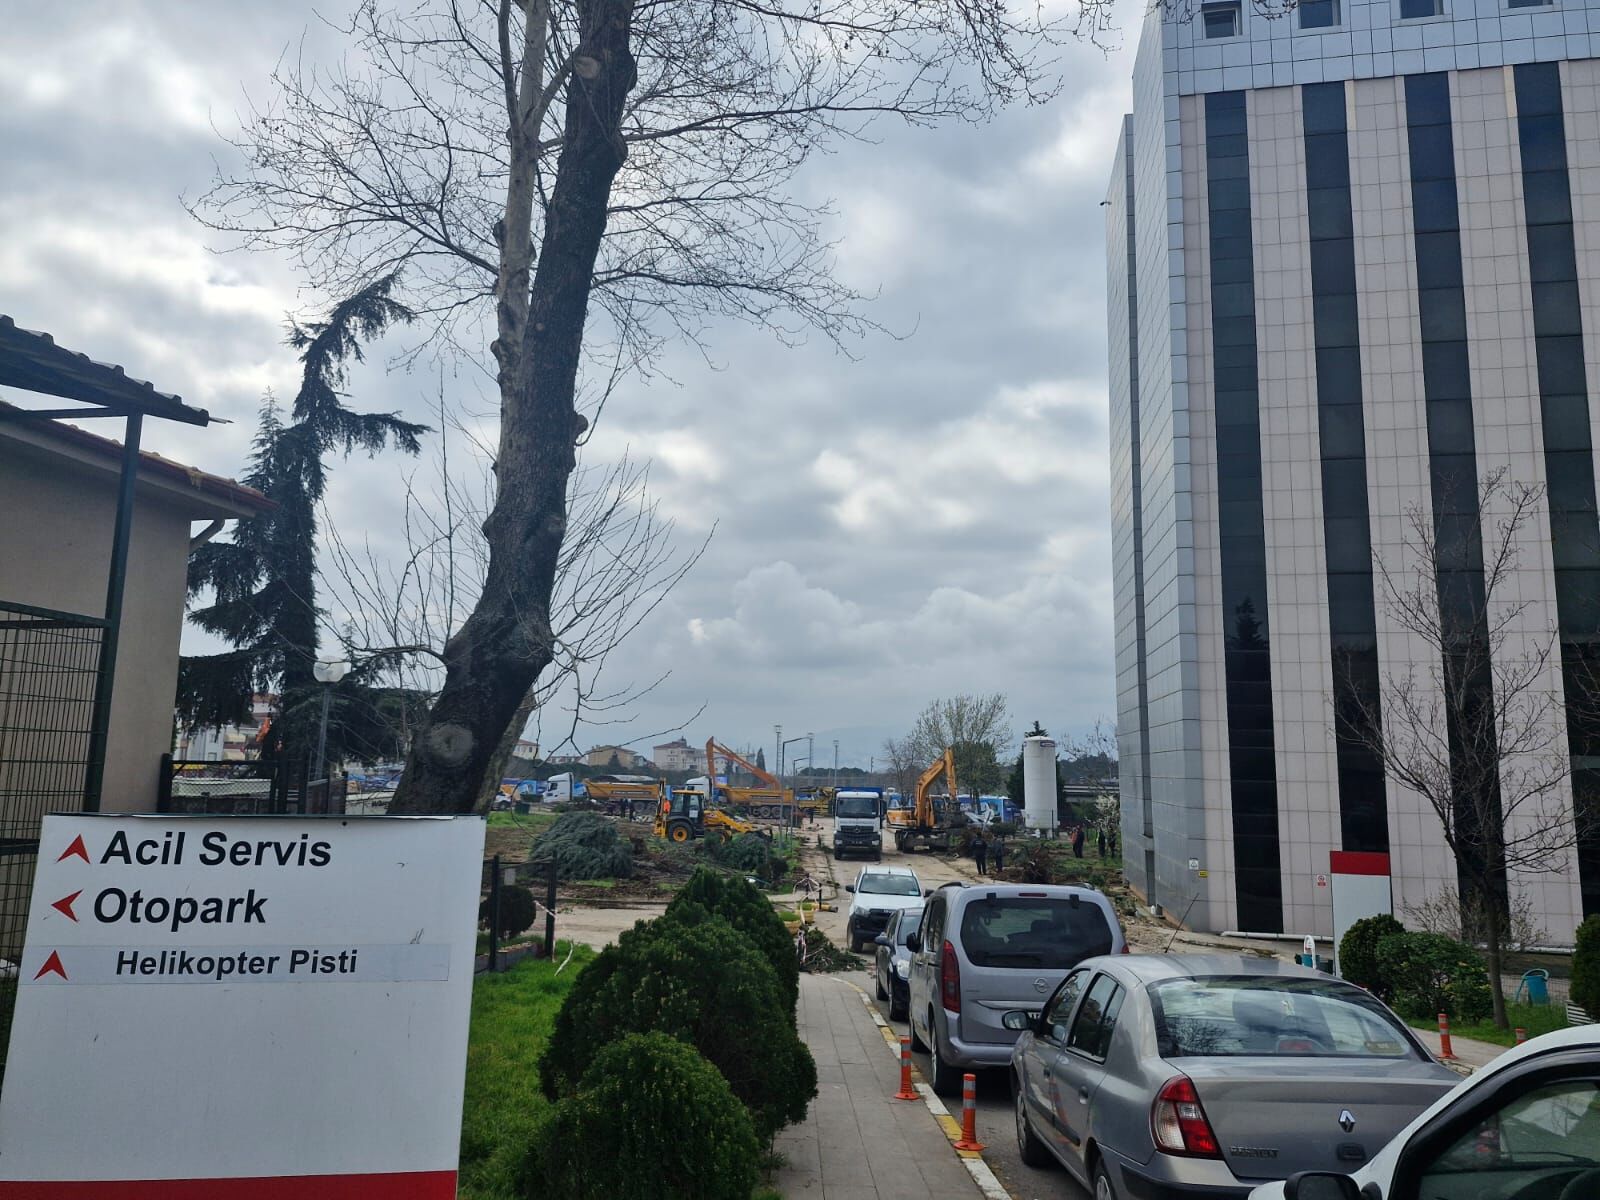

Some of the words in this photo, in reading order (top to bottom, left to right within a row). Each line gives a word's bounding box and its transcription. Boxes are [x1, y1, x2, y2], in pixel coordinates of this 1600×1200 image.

[100, 830, 186, 865] Acil
[199, 832, 332, 867] Servis
[94, 888, 268, 932] Otopark
[116, 951, 280, 980] Helikopter
[289, 950, 358, 974] Pisti
